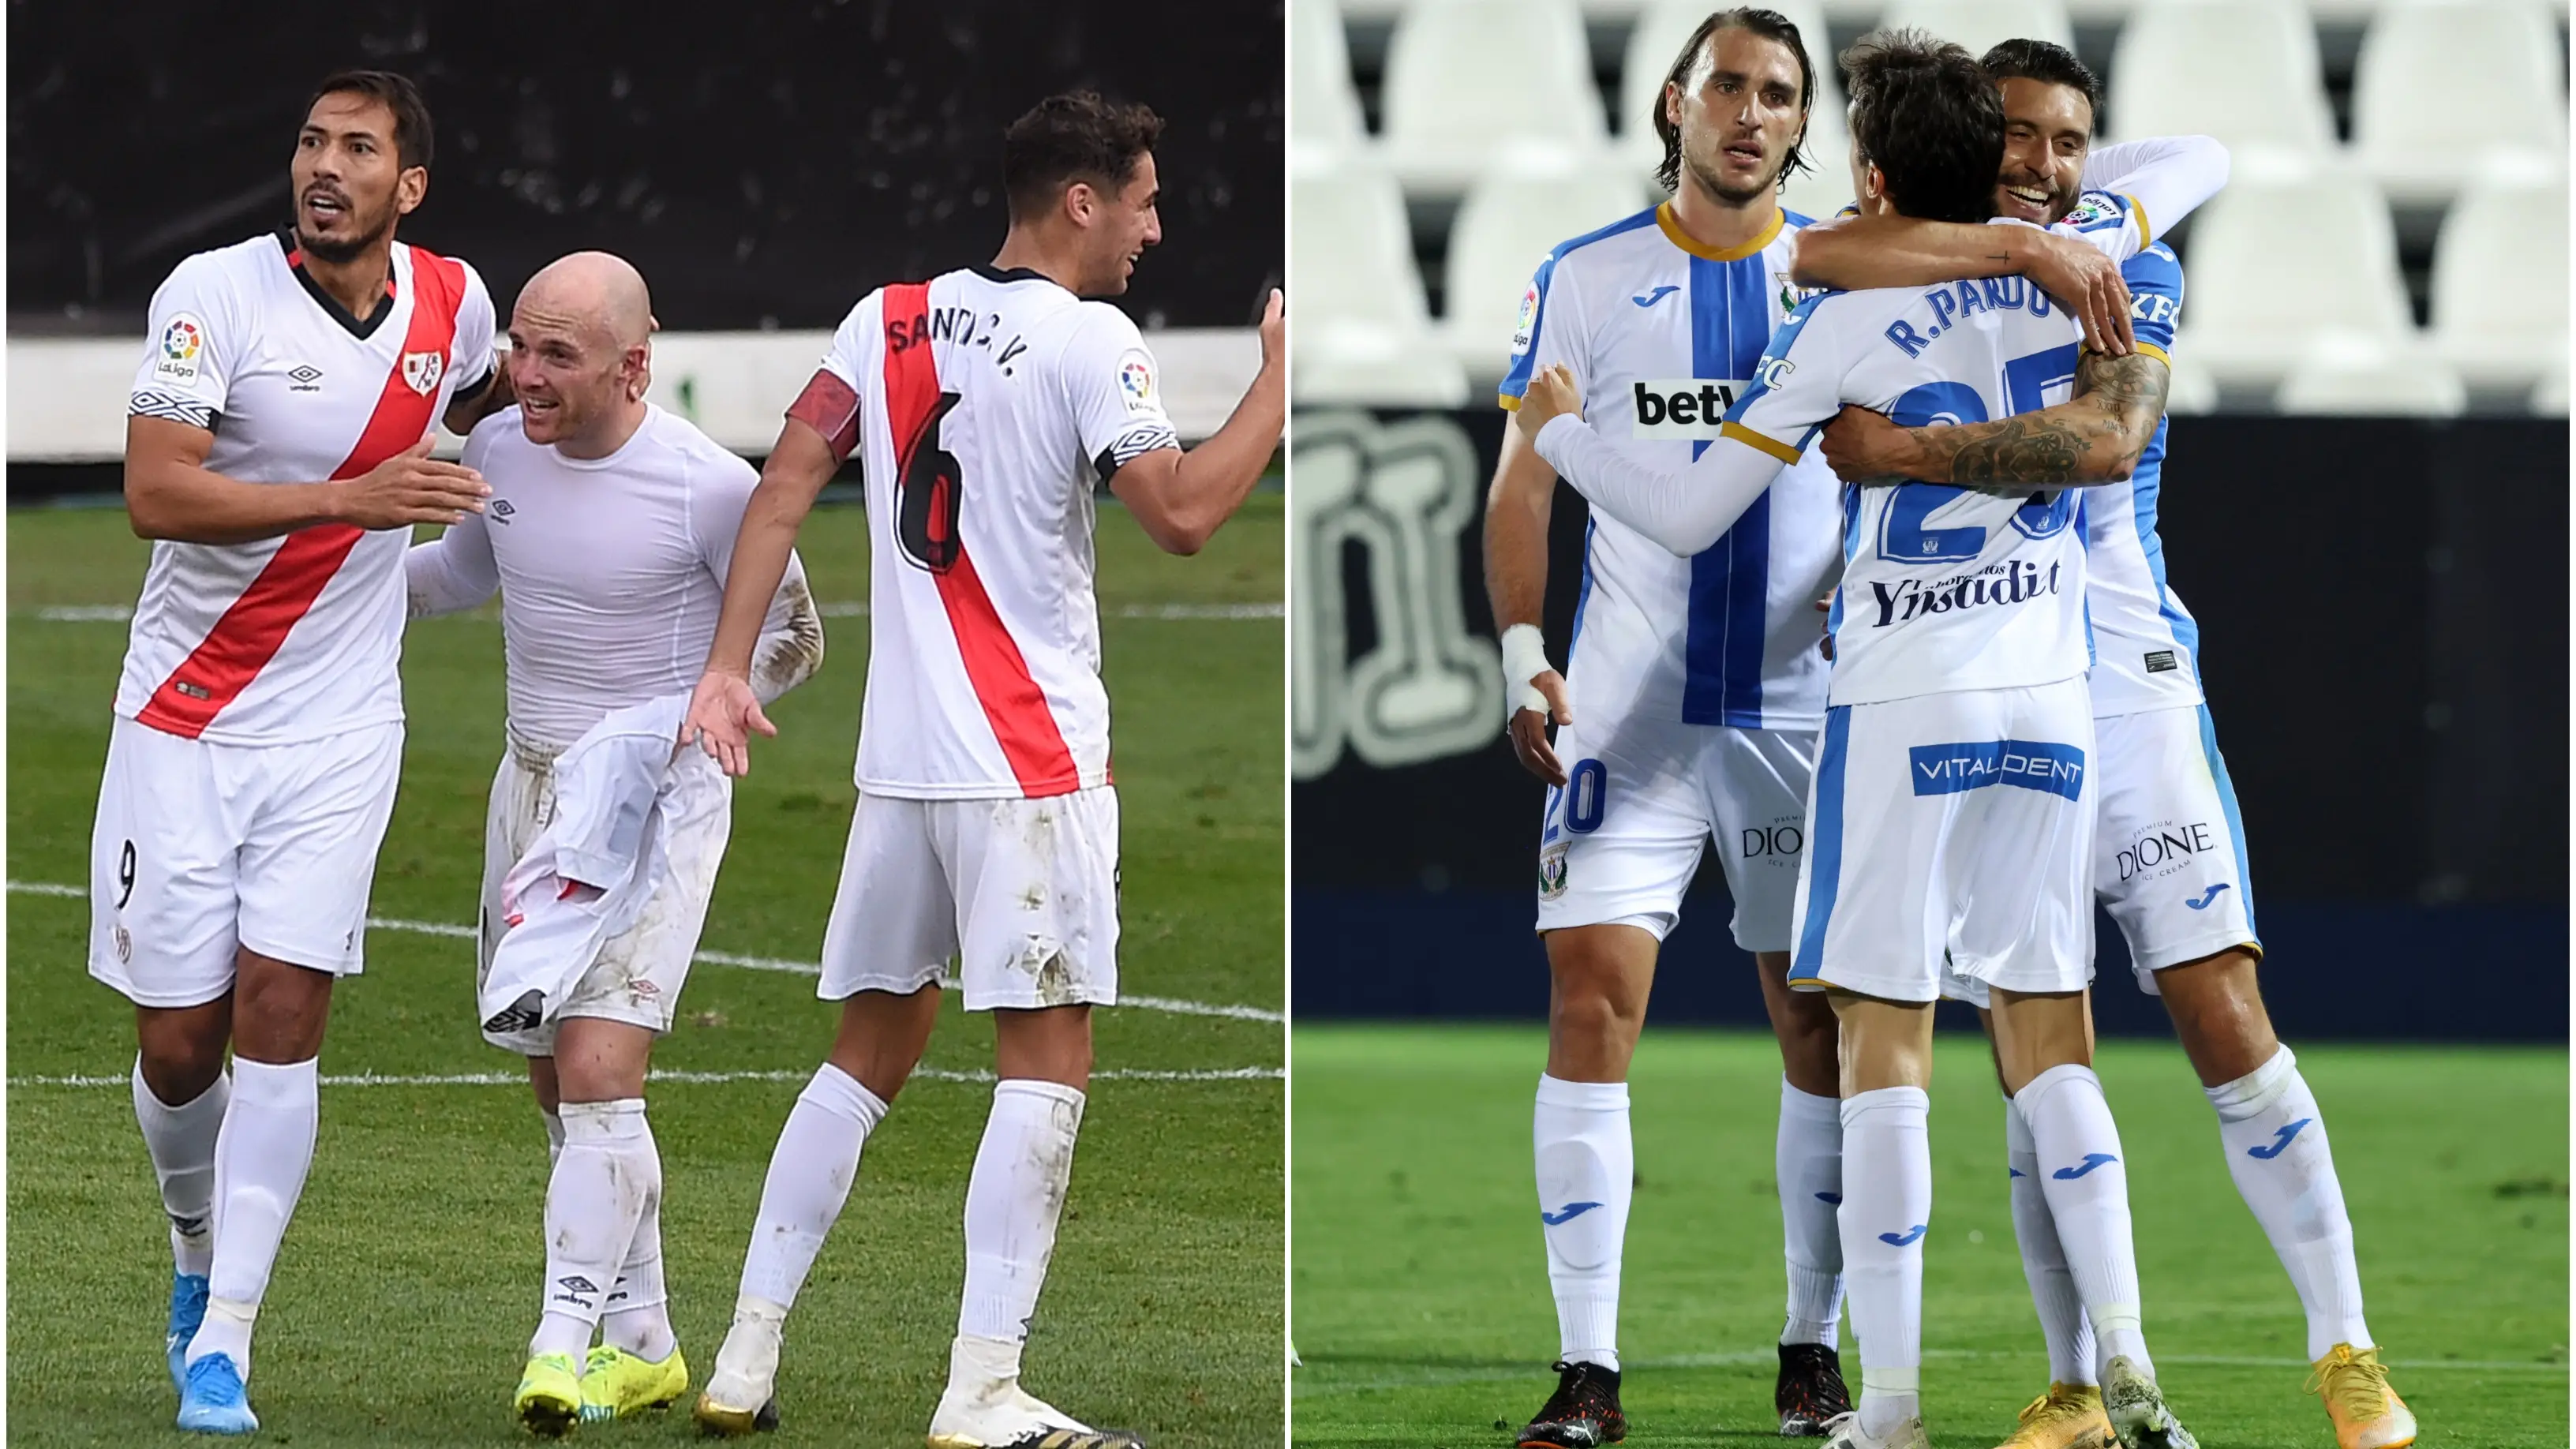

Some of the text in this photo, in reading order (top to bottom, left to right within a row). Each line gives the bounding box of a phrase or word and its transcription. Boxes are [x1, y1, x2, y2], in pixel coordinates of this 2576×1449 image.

[2082, 197, 2117, 215] LaLiga
[158, 361, 194, 377] LaLiga
[893, 391, 962, 575] 6
[1869, 559, 2061, 628] Ynsadit
[1919, 754, 2082, 783] VITALDENT
[1774, 814, 1806, 825] PREMI
[2132, 820, 2173, 838] PREMIUM
[1742, 826, 1803, 859] DIO
[2115, 822, 2215, 882] DIONE
[119, 839, 136, 909] 9
[2159, 859, 2192, 877] CREAM
